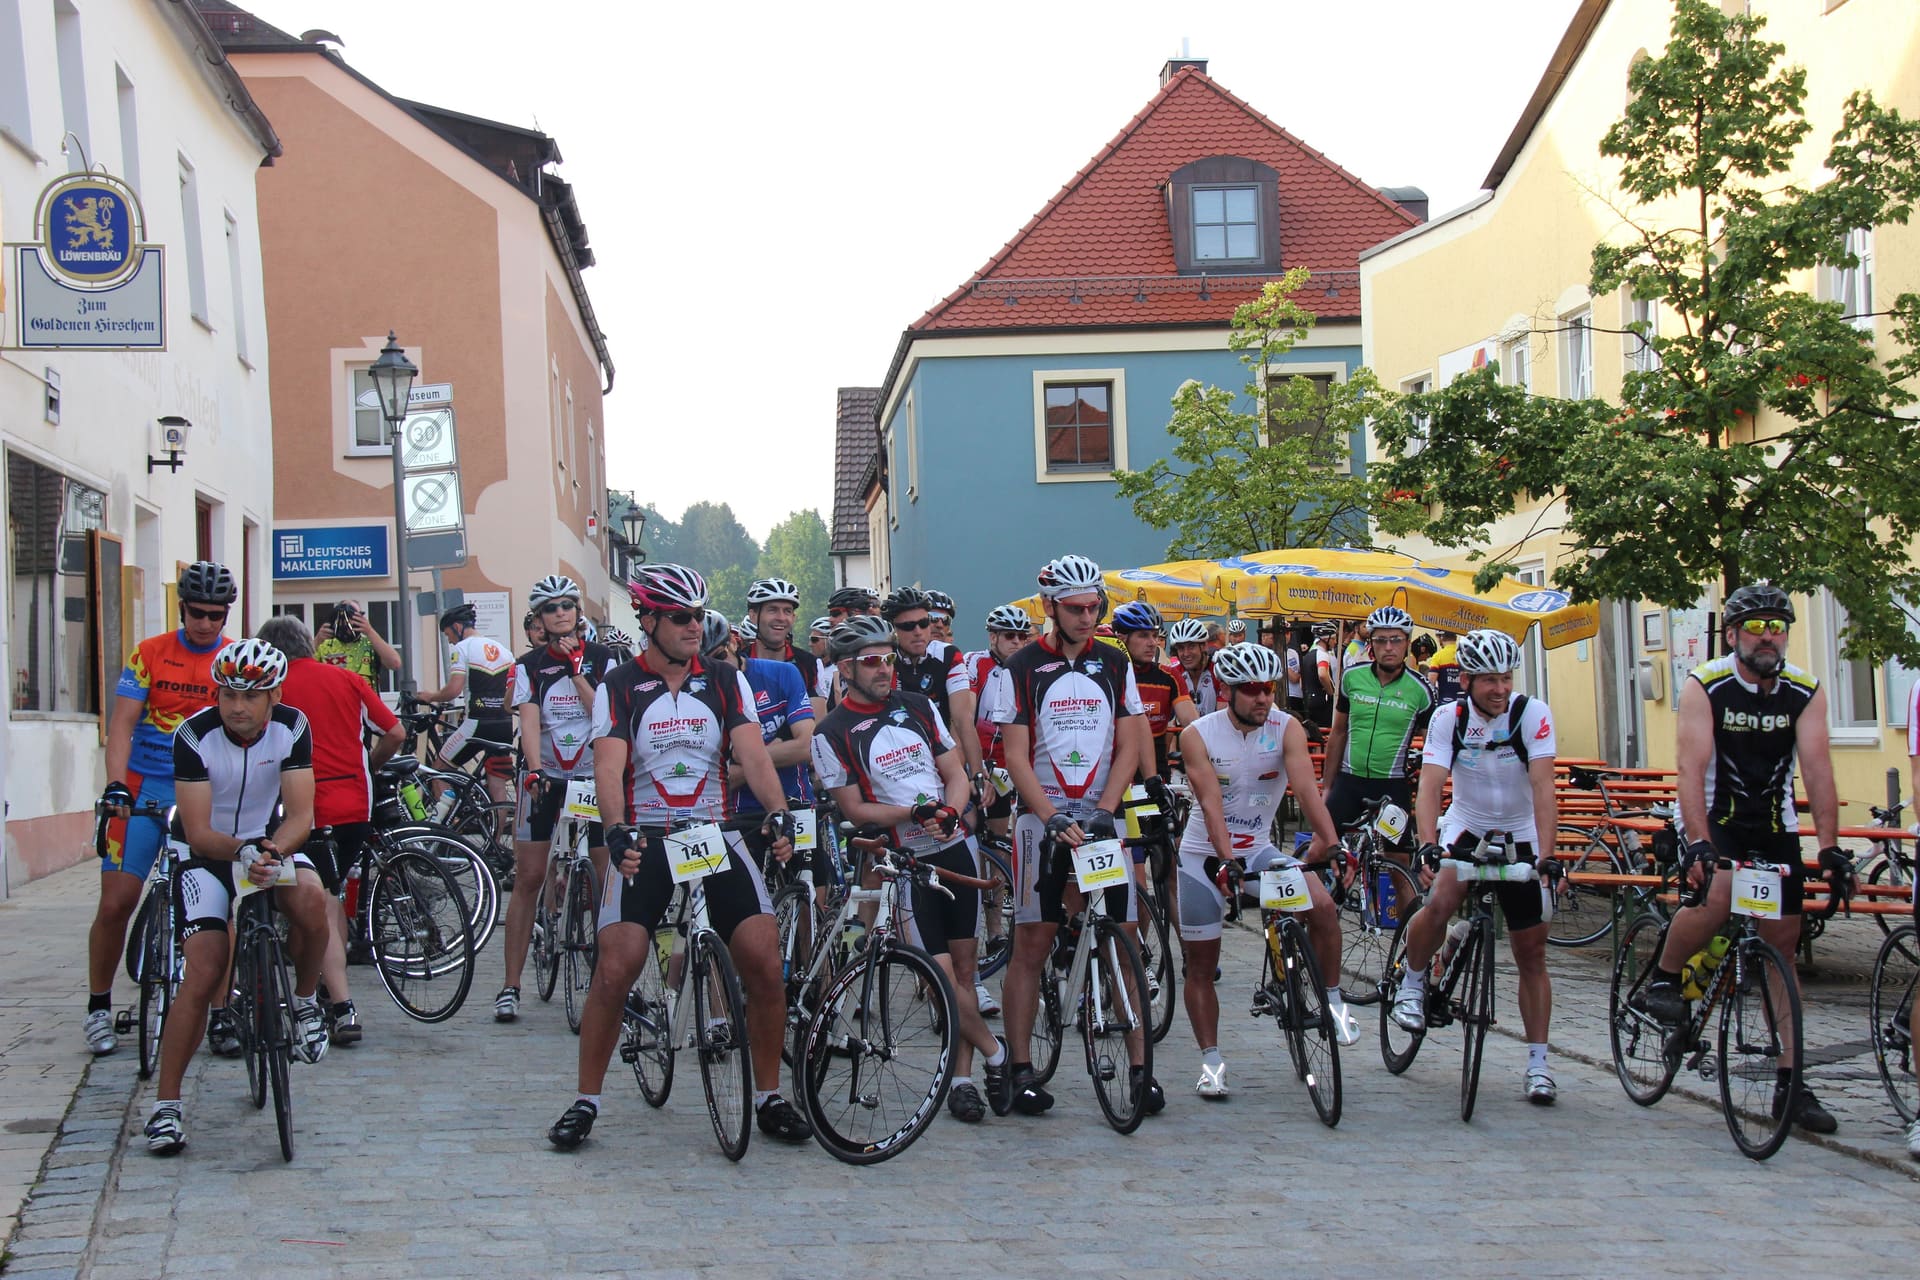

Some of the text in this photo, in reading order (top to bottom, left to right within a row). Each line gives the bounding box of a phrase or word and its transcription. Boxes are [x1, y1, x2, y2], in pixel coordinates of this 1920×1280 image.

[60, 250, 121, 261] LÖWENBRÄU
[77, 297, 107, 315] Zum
[31, 317, 90, 331] Goldenen
[413, 426, 435, 442] 30
[413, 453, 441, 464] ZONE
[418, 514, 447, 526] ZONE
[307, 546, 372, 557] DEUTSCHES
[281, 558, 372, 572] MAKLERFORUM
[1049, 697, 1102, 708] meixner
[648, 717, 708, 731] meixner
[875, 742, 922, 764] meixner
[577, 792, 597, 807] 140
[1389, 816, 1397, 826] 6
[681, 841, 710, 861] 141
[1088, 854, 1114, 871] 137
[1276, 884, 1295, 898] 16
[1751, 885, 1770, 900] 19
[875, 1048, 949, 1150] VUELTA
